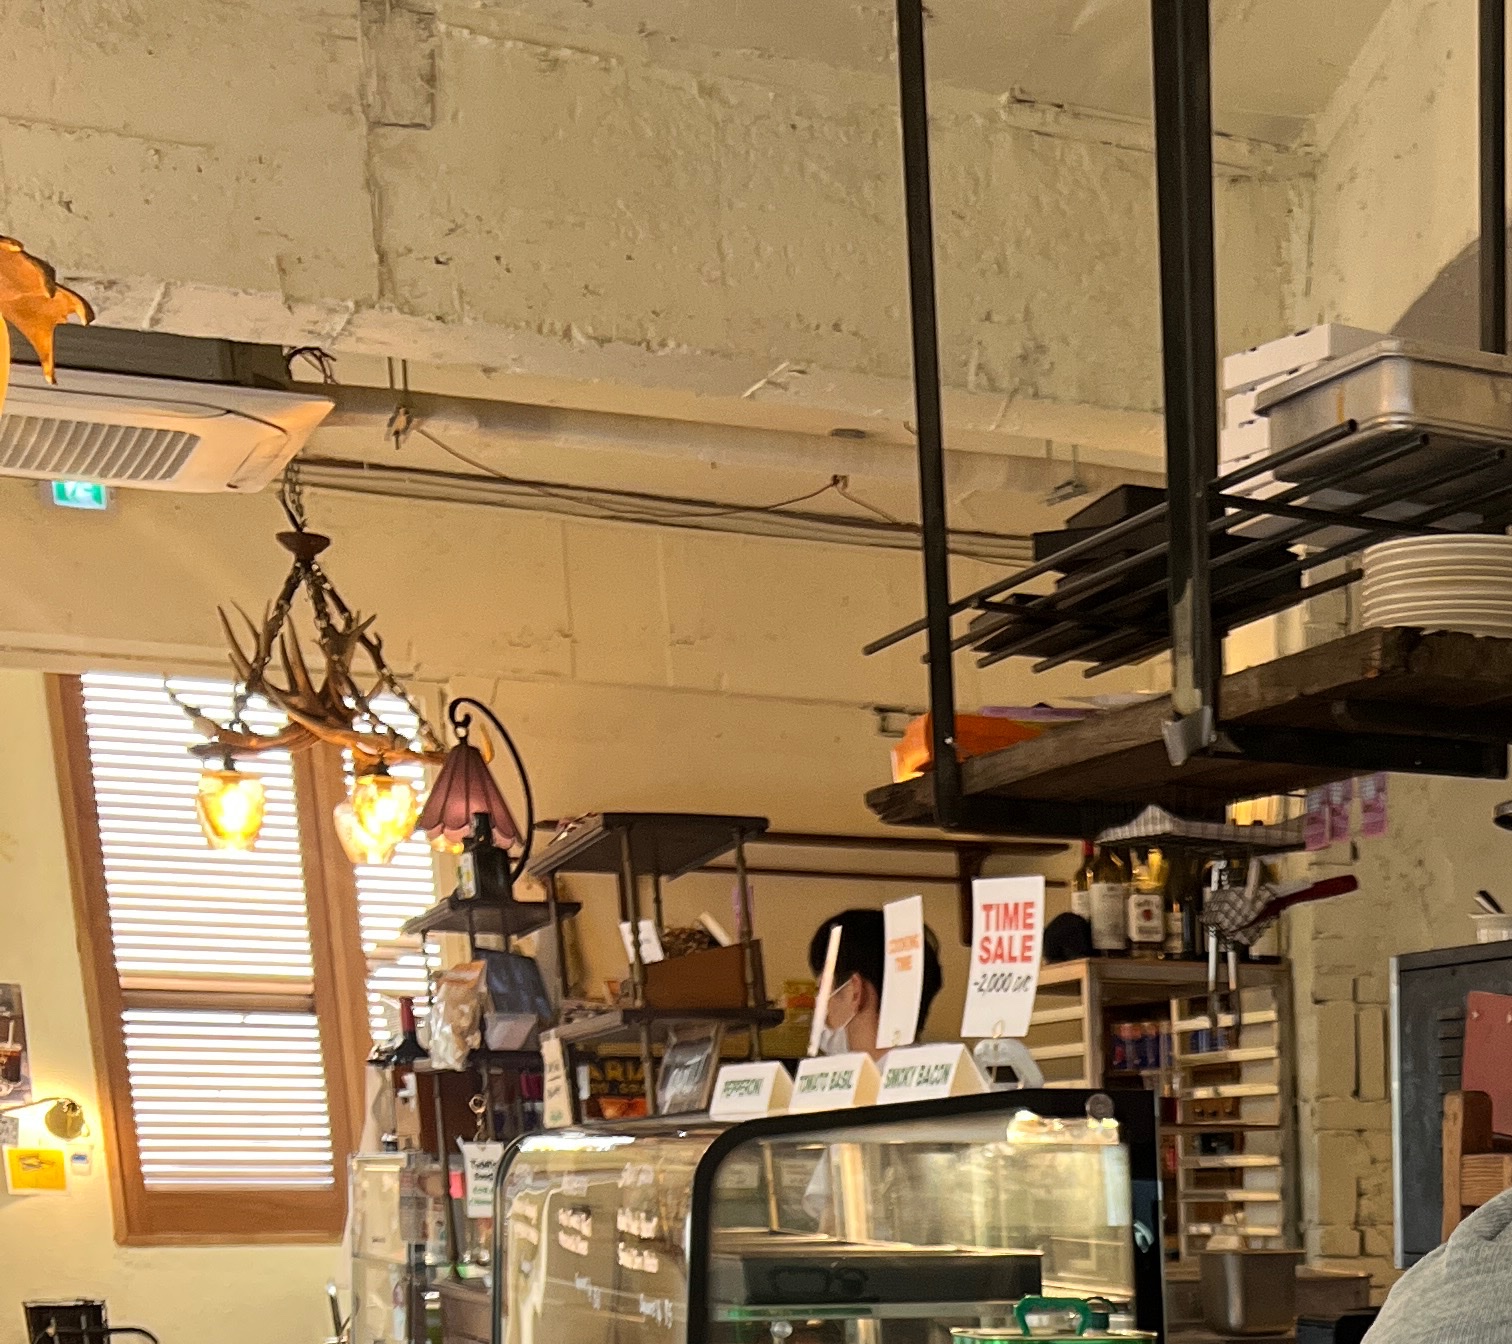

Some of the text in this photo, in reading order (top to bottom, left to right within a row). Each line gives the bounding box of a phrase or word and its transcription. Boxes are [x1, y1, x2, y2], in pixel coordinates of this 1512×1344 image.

[980, 901, 1036, 932] TIME
[978, 935, 1034, 965] SALE
[916, 1063, 954, 1087] BACON
